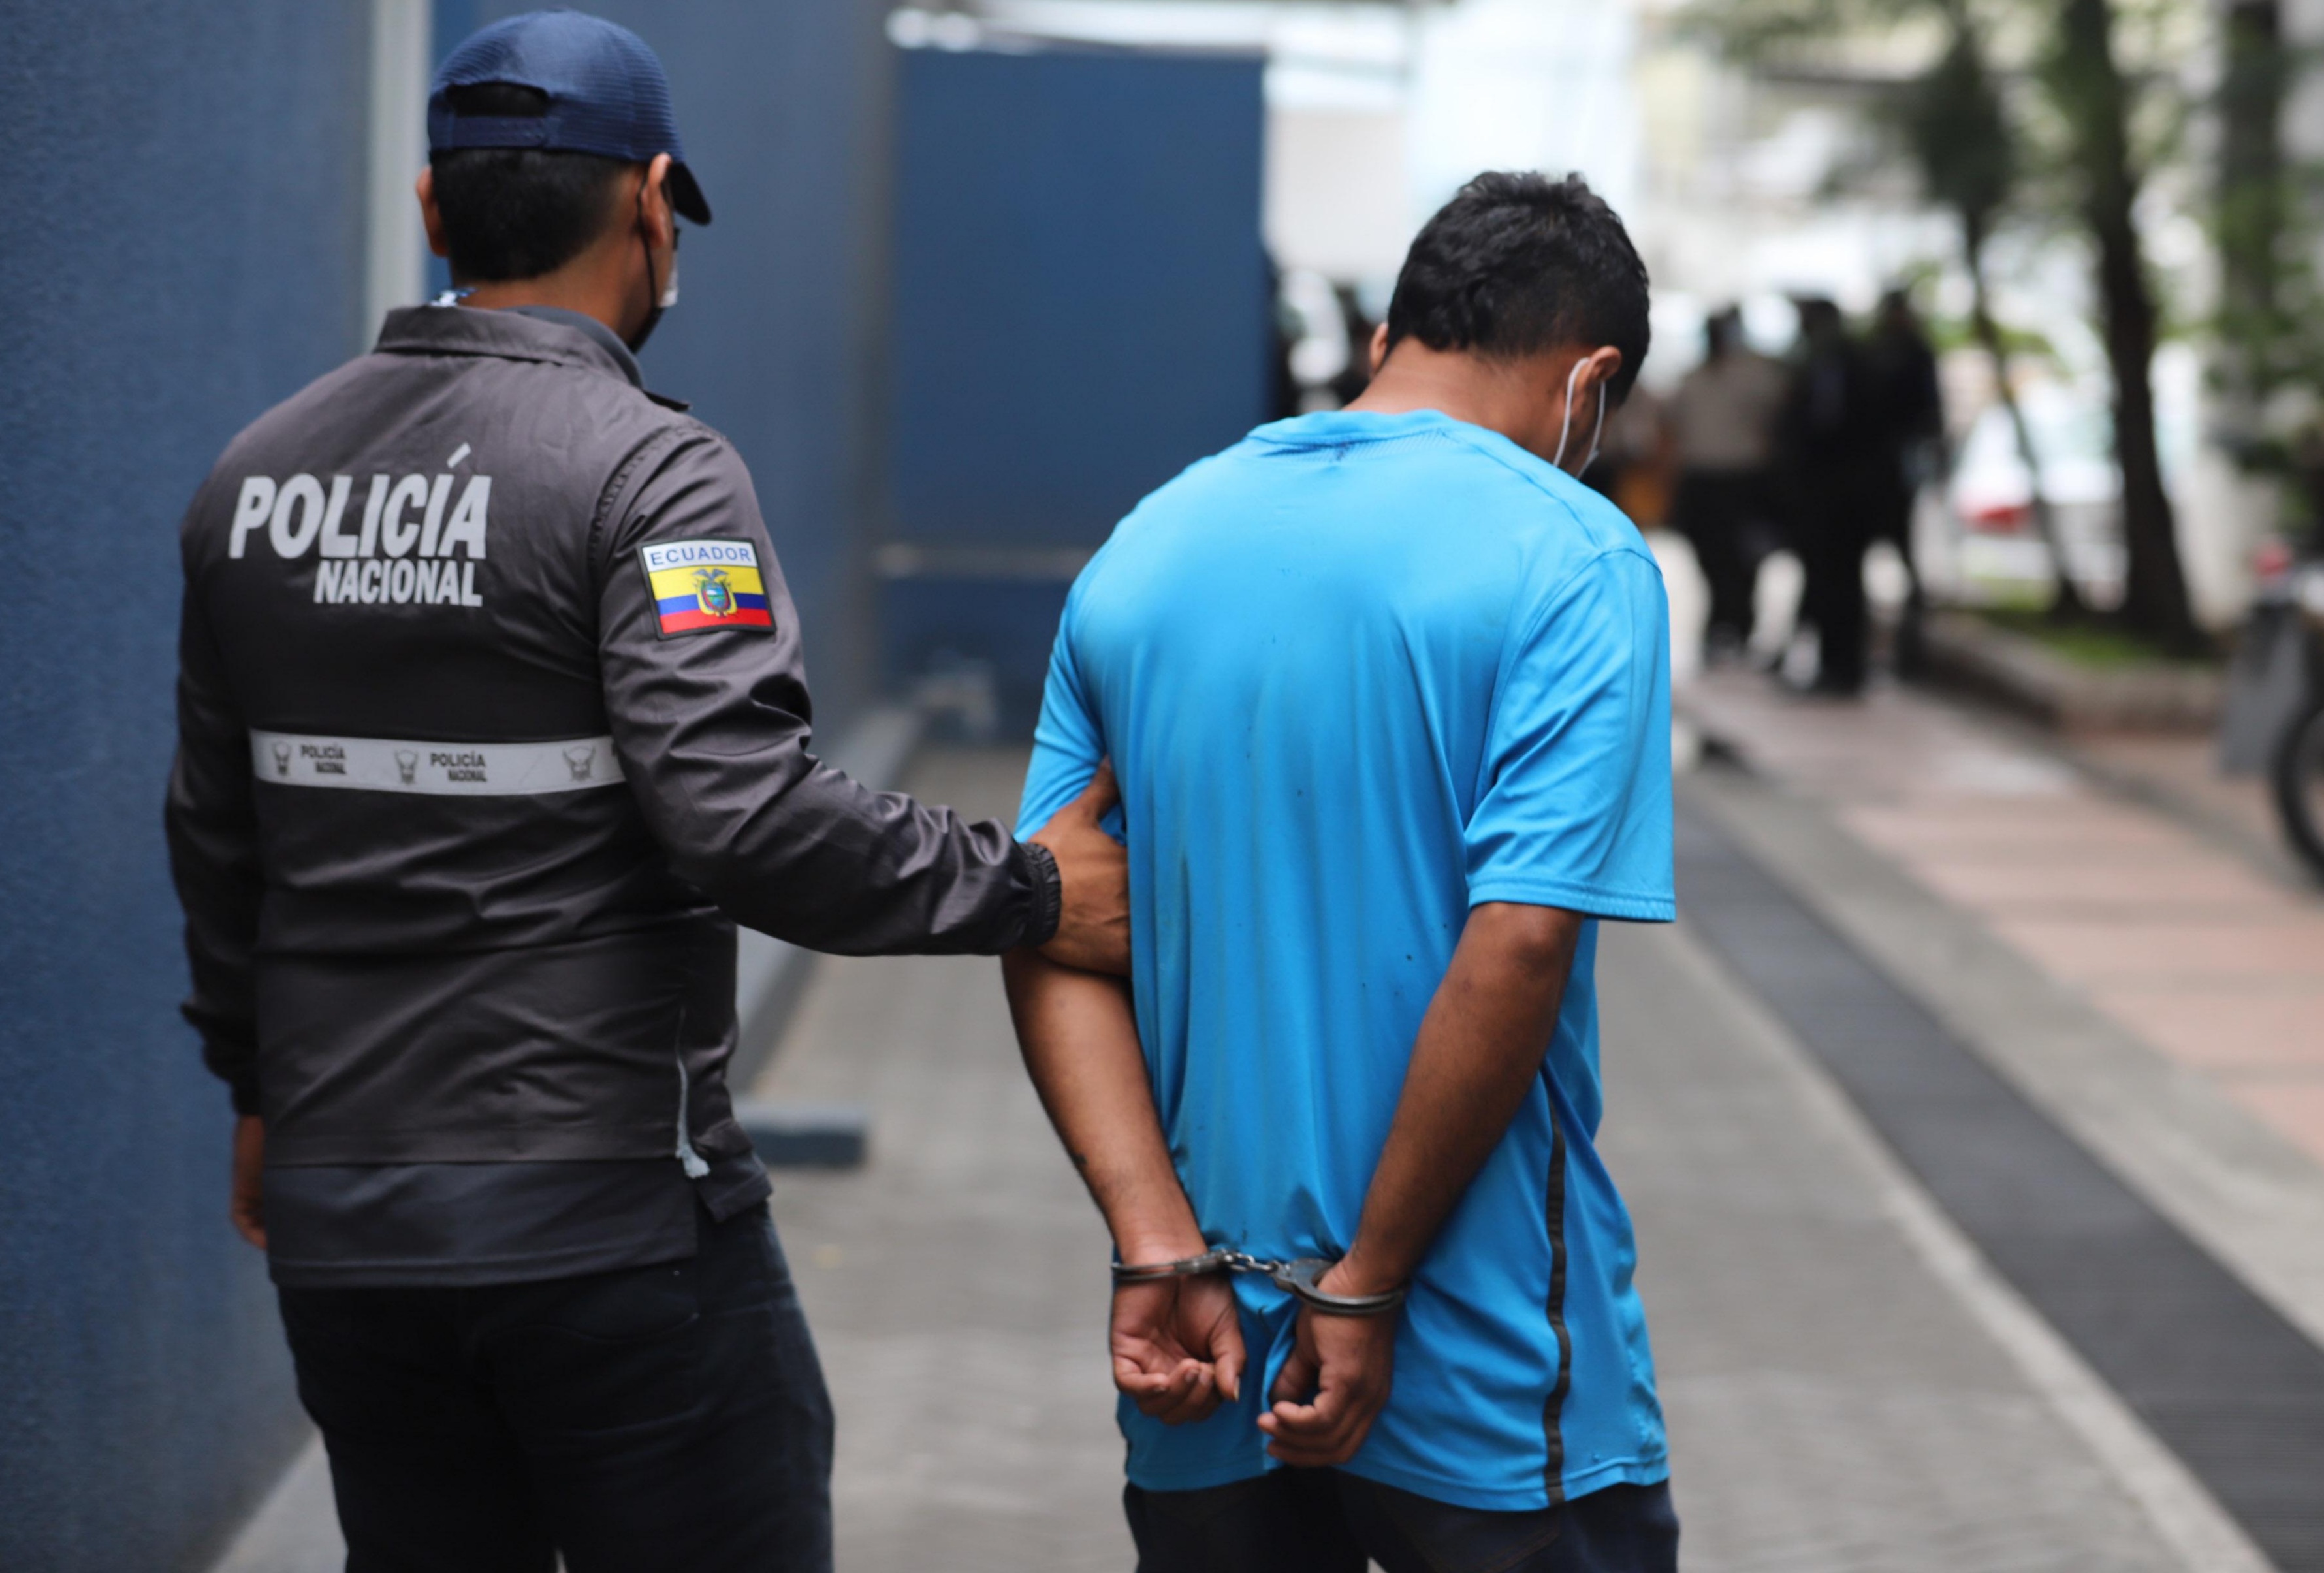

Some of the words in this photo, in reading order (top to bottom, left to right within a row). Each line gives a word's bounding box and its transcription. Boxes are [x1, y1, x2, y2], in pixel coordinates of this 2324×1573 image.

[228, 441, 492, 559] POLICÍA
[650, 547, 752, 566] ECUADOR
[313, 559, 483, 607] NACIONAL
